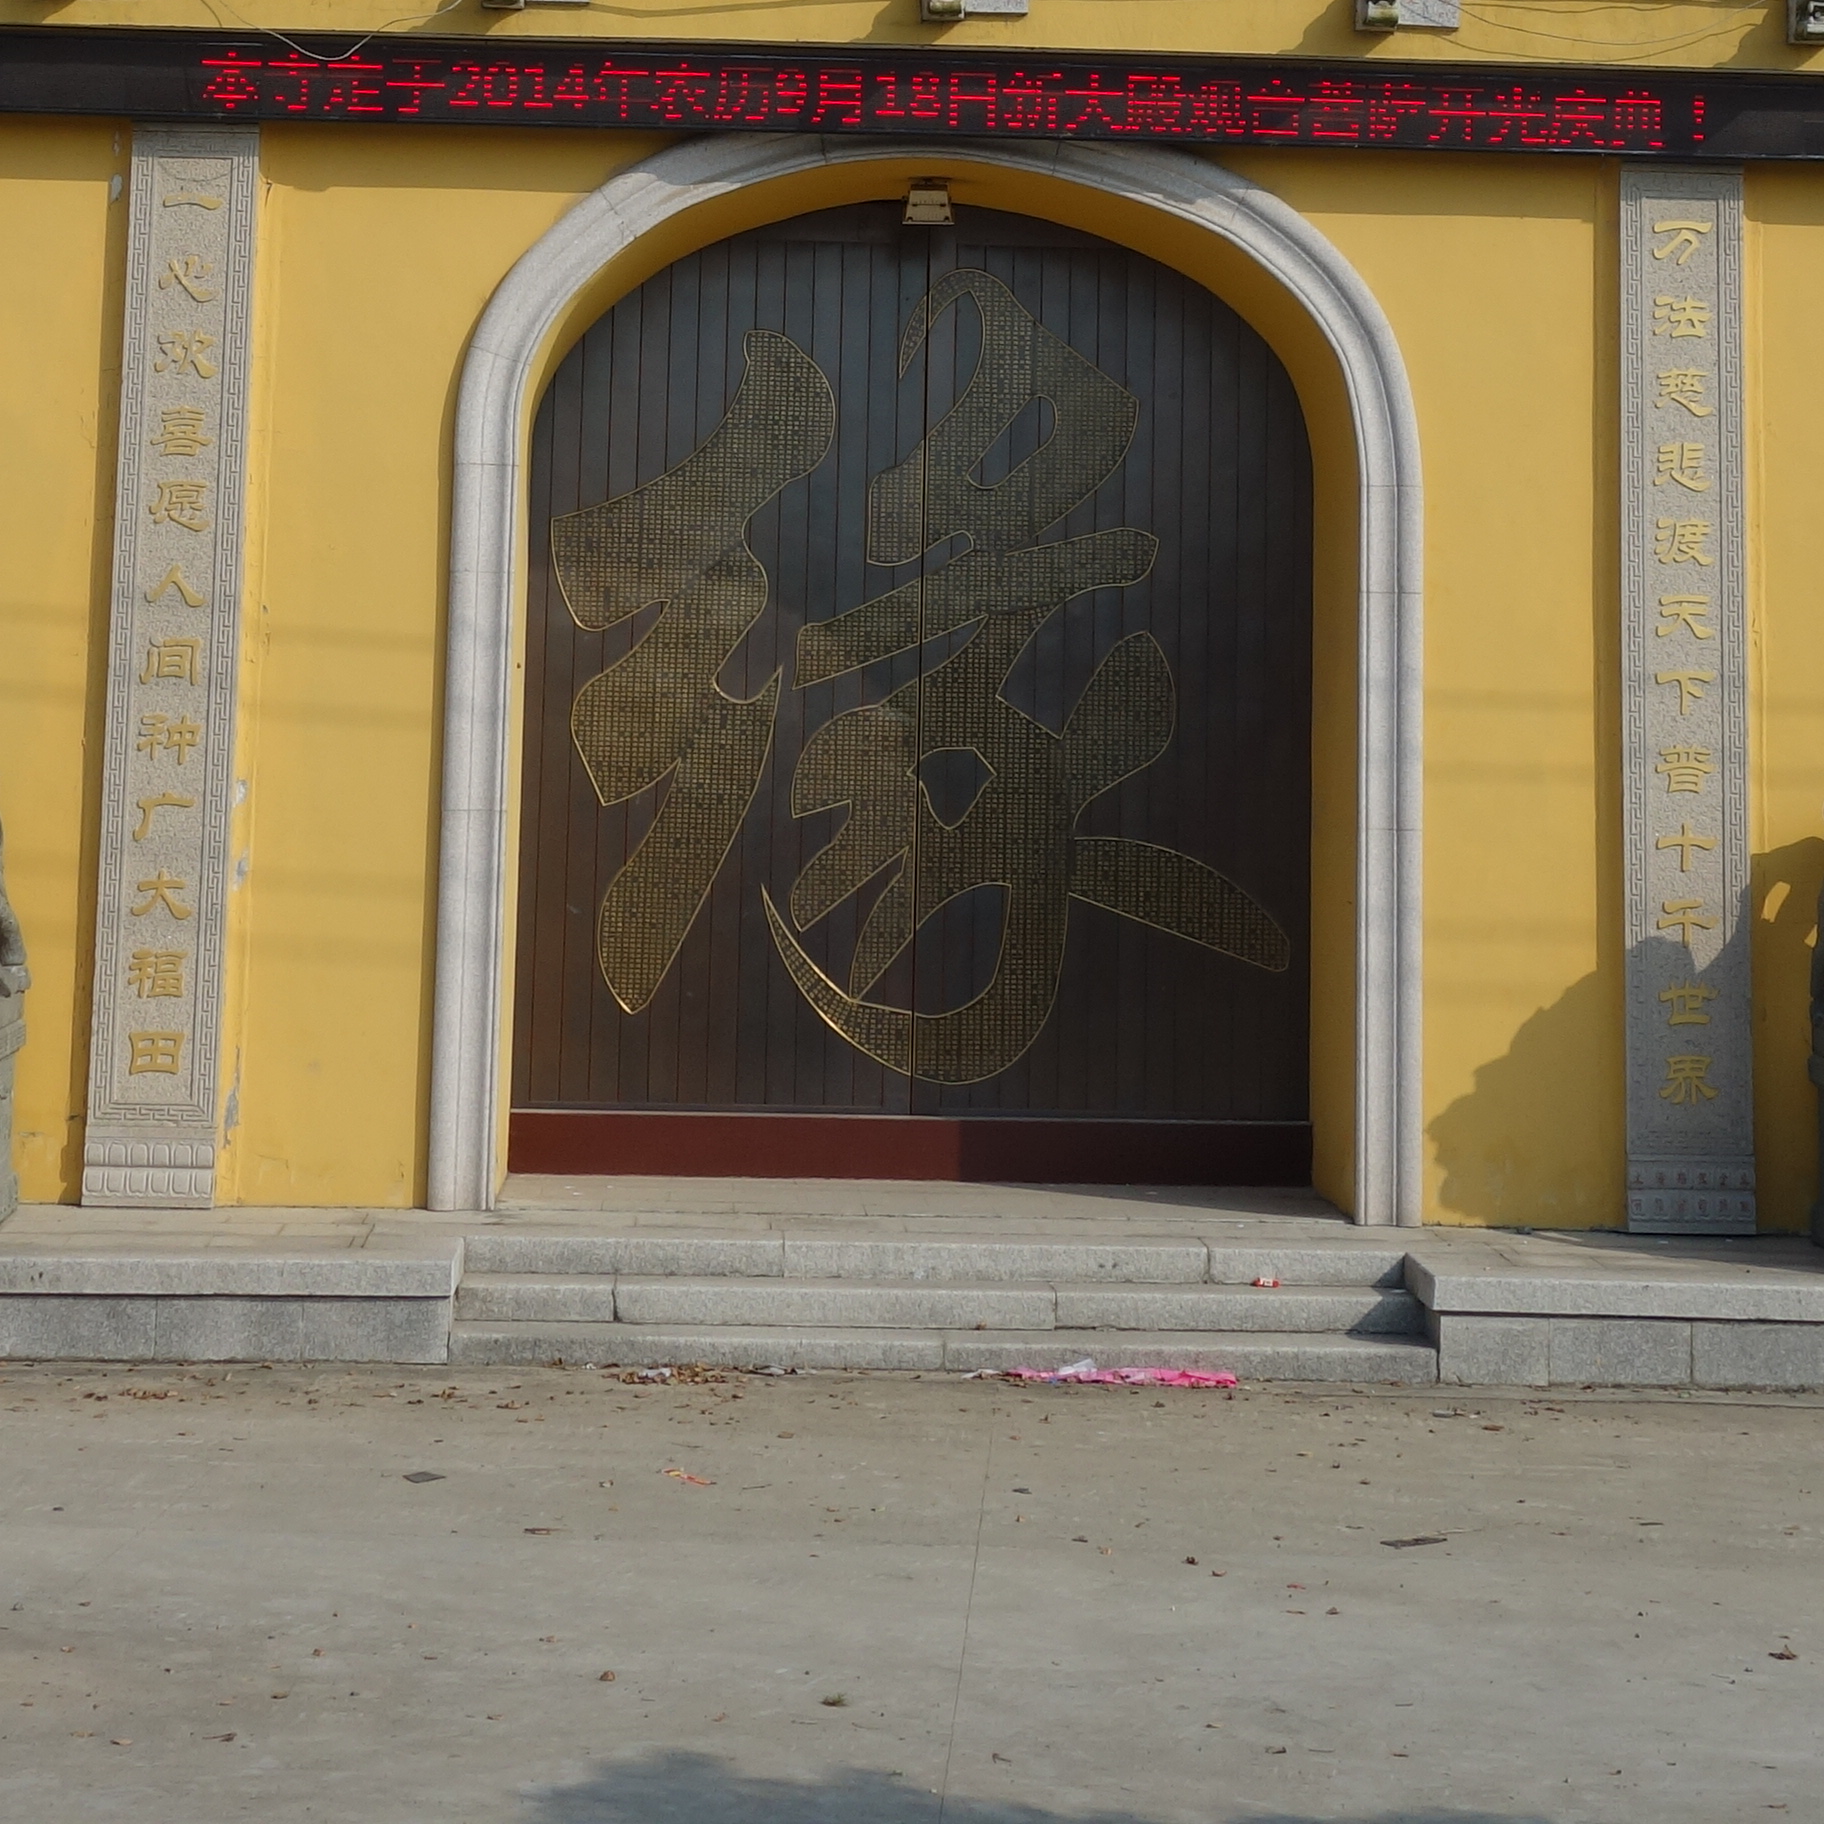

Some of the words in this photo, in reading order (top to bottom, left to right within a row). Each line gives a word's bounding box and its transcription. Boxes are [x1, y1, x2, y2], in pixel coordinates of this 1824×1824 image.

[127, 193, 225, 1077] 一心欢喜愿人间种广大福田
